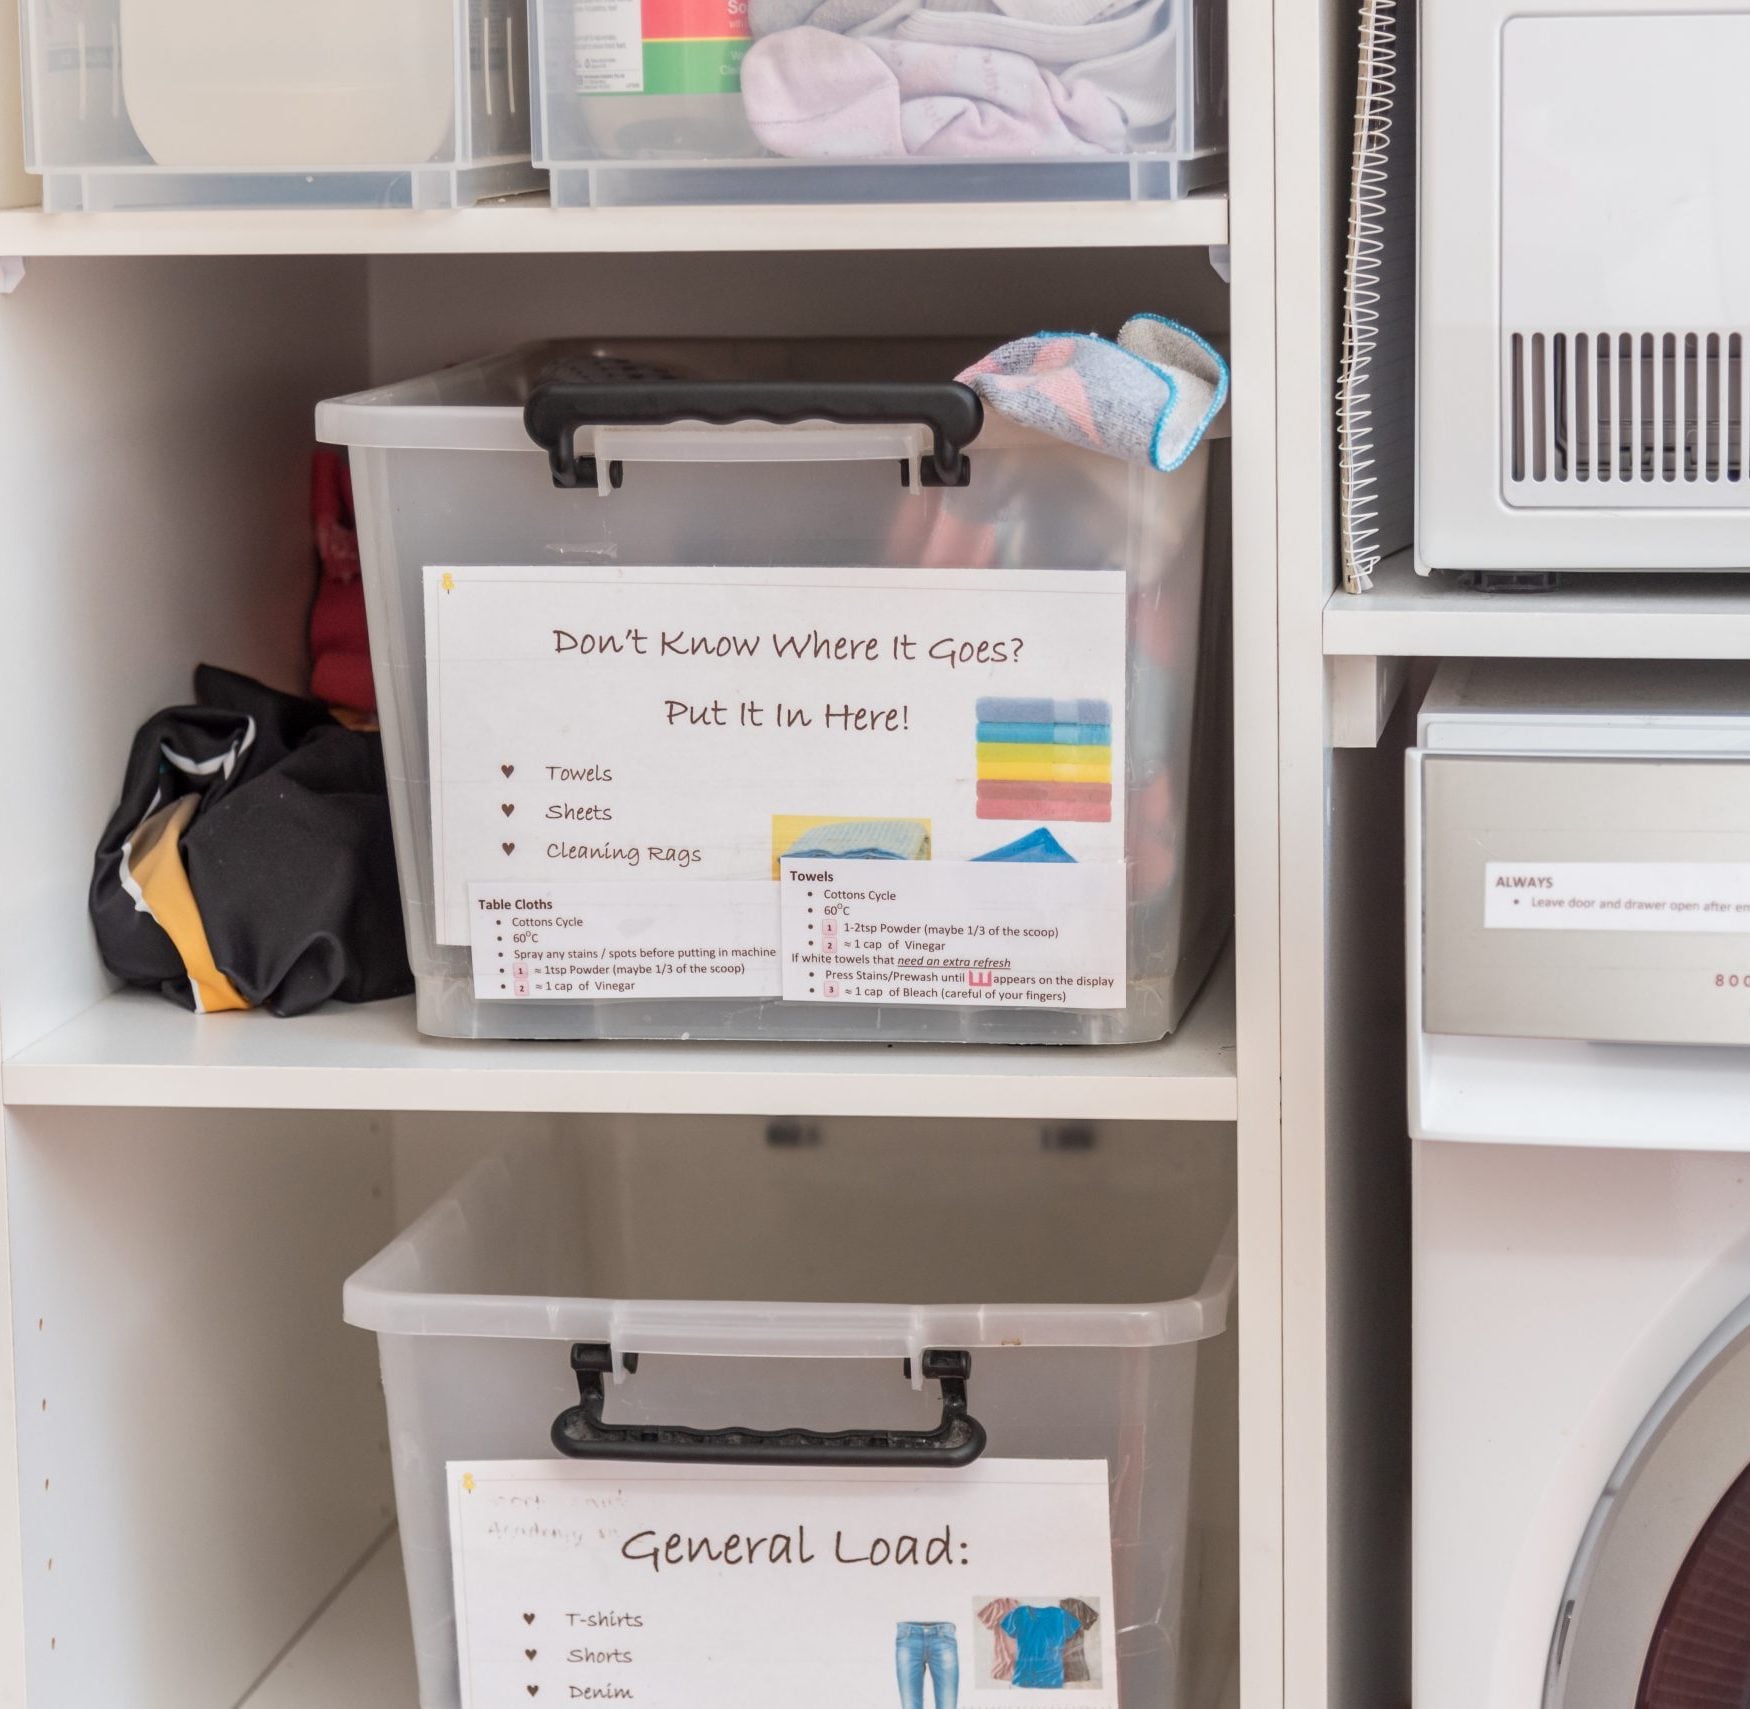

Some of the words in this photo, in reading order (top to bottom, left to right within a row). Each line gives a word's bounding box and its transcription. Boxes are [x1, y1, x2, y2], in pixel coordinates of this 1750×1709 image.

[553, 630, 648, 654] Don't
[660, 631, 760, 657] Know
[773, 630, 878, 661] Where
[893, 635, 917, 660] It
[928, 637, 1024, 669] Goes?
[665, 701, 727, 726] Put
[740, 702, 763, 727] It
[777, 703, 812, 727] In
[825, 704, 909, 731] Here!
[546, 764, 612, 782] Towels
[546, 803, 612, 821] Sheets
[547, 842, 640, 866] Cleaning
[648, 847, 701, 867] Rags
[790, 870, 834, 882] Towels
[1496, 876, 1553, 889] ALWAYS
[824, 889, 865, 900] Cottons
[868, 890, 896, 902] Cycle
[478, 899, 511, 910] Table
[515, 898, 552, 910] Cloths
[1531, 897, 1565, 909] Leave
[1567, 898, 1595, 909] door
[1598, 898, 1621, 910] and
[1624, 899, 1667, 911] drawer
[1670, 902, 1700, 914] open
[1703, 900, 1731, 913] after
[512, 917, 552, 927] Cottons
[555, 916, 583, 928] Cycle
[844, 923, 877, 934] 1-2tsp
[880, 923, 921, 934] Powder
[924, 924, 964, 937] (maybe
[968, 925, 985, 937] 1/3
[989, 925, 1001, 936] of
[1002, 926, 1020, 937] the
[1023, 927, 1059, 939] scoop)
[514, 949, 543, 960] Spray
[546, 951, 565, 960] any
[568, 949, 598, 959] stains
[609, 949, 637, 960] spots
[640, 948, 674, 958] before
[678, 947, 715, 959] putting
[718, 947, 728, 957] in
[731, 947, 777, 957] machine
[855, 940, 860, 949] 1
[863, 942, 882, 952] cap
[888, 940, 900, 950] of
[905, 940, 946, 952] Vinegar
[792, 953, 798, 963] If
[802, 952, 831, 964] white
[835, 953, 869, 965] towels
[873, 954, 894, 965] that
[898, 955, 923, 966] need
[926, 957, 940, 966] an
[943, 957, 970, 967] extra
[974, 957, 1011, 969] refresh
[545, 965, 566, 976] 1tsp
[570, 964, 609, 975] Powder
[612, 964, 651, 977] (maybe
[656, 964, 673, 975] 1/3
[676, 963, 689, 974] of
[691, 963, 706, 974] the
[710, 963, 745, 976] scoop)
[546, 981, 551, 991] 1
[554, 983, 573, 993] cap
[578, 981, 589, 991] of
[595, 981, 635, 992] Vinegar
[826, 970, 853, 980] Press
[857, 970, 938, 982] Stains/Prewash
[941, 972, 965, 983] until
[993, 976, 1036, 987] appears
[1038, 976, 1052, 985] on
[1056, 975, 1073, 986] the
[1076, 976, 1114, 988] display
[856, 986, 861, 996] 1
[865, 988, 883, 998] cap
[889, 986, 901, 997] of
[904, 986, 938, 998] Bleach
[941, 988, 982, 999] (careful
[984, 989, 996, 999] of
[999, 990, 1023, 1001] your
[1026, 990, 1066, 1003] fingers)
[622, 1526, 815, 1572] General
[835, 1525, 969, 1565] Load:
[566, 1611, 644, 1628] T-shirts
[566, 1648, 633, 1664] Shorts
[569, 1684, 634, 1699] Denim
